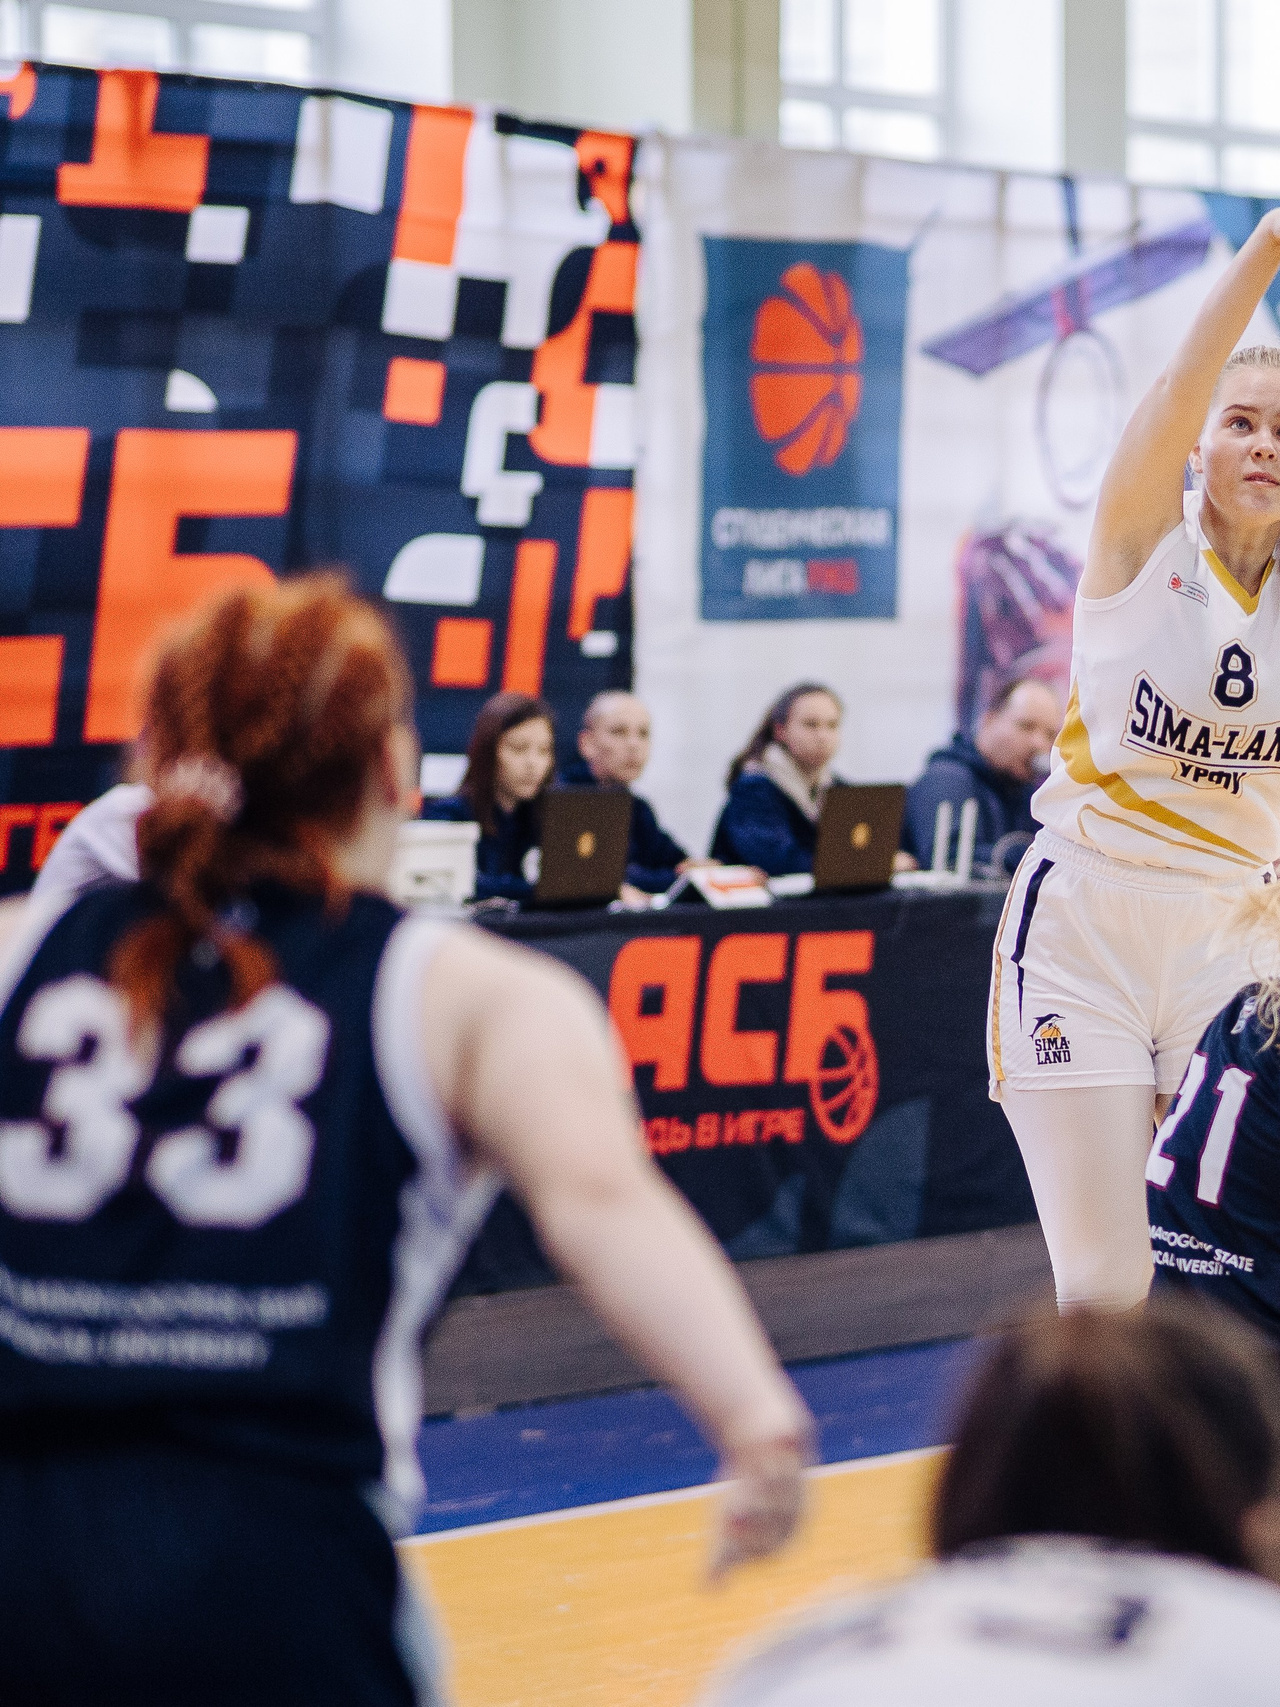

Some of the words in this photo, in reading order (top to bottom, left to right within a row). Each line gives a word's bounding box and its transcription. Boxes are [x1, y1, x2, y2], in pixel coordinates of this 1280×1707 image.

[1213, 641, 1257, 709] 8
[608, 929, 876, 1092] АСБ
[1035, 1049, 1071, 1066] LAND
[0, 971, 332, 1229] 33
[1144, 1051, 1254, 1206] 21
[1213, 1247, 1255, 1273] STATE
